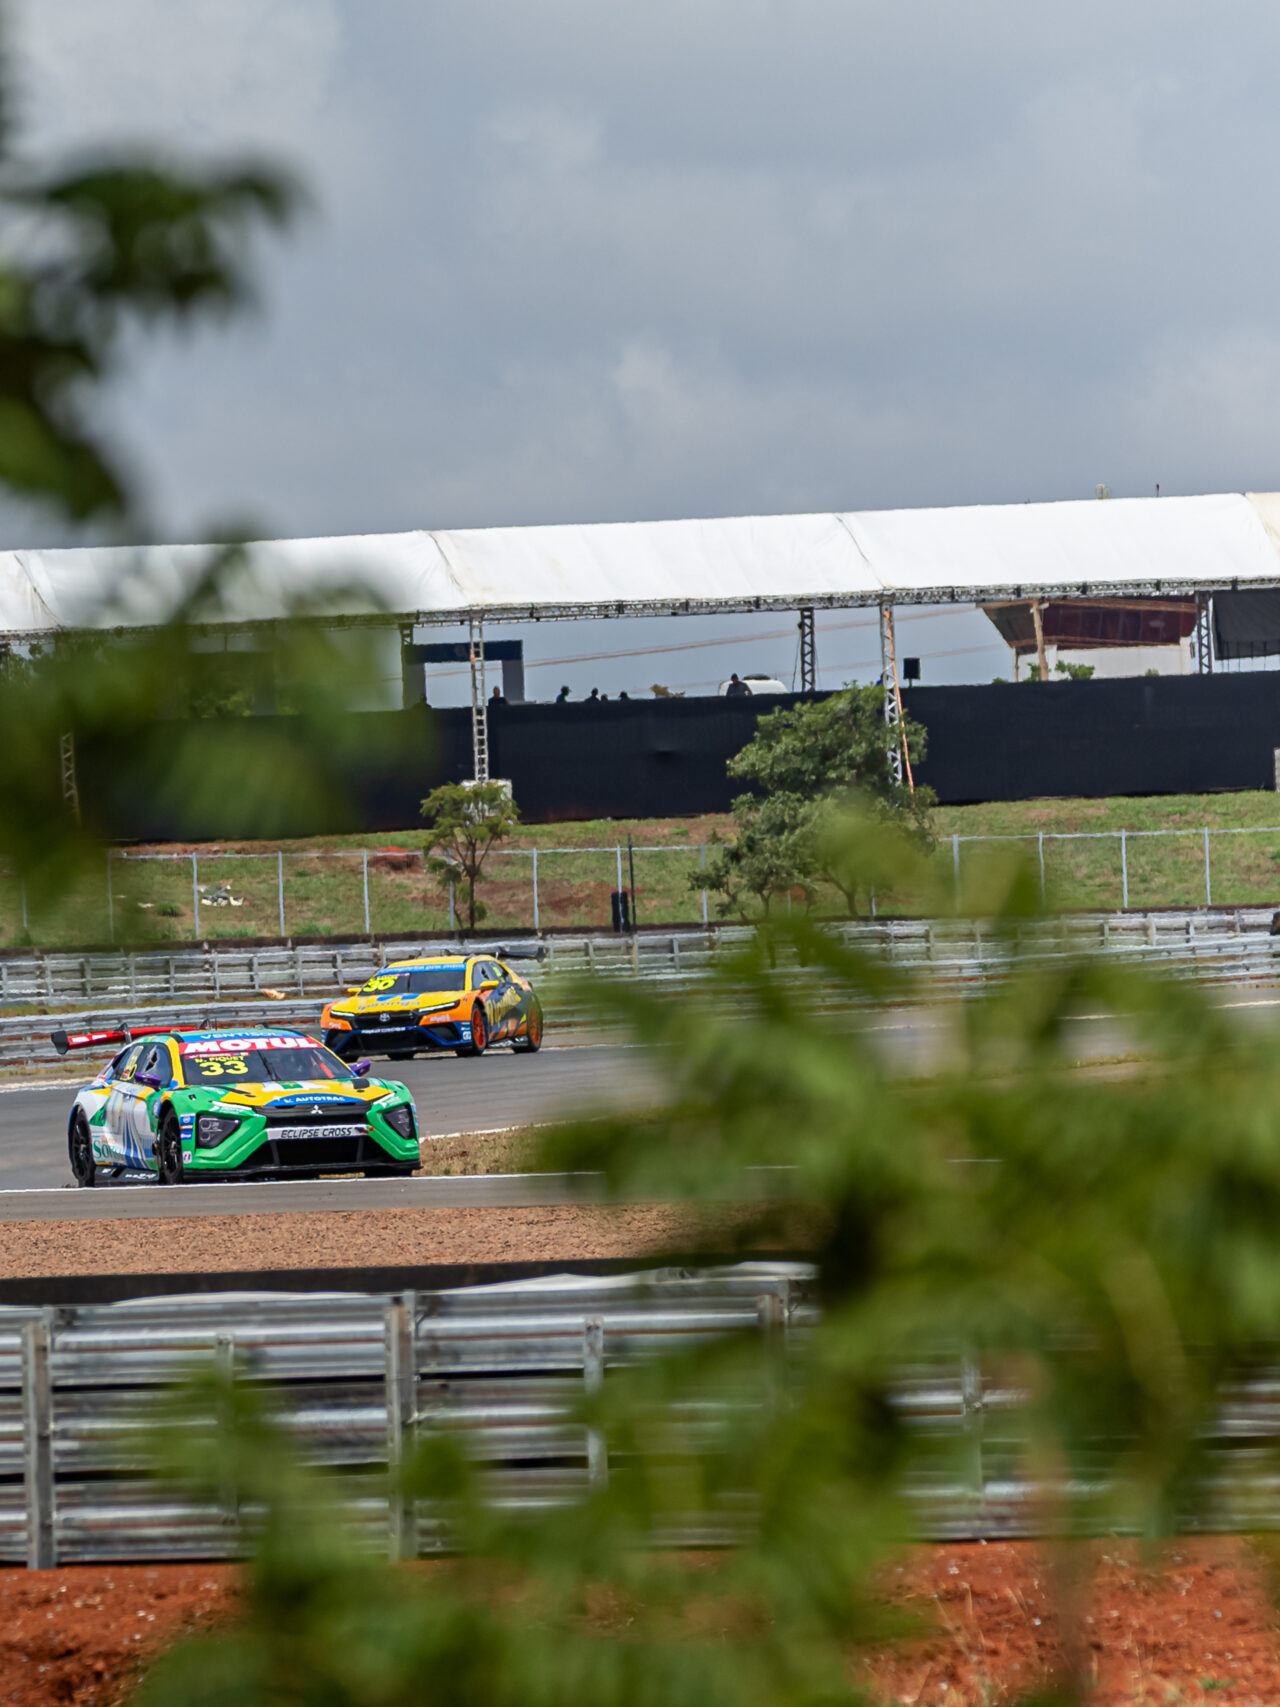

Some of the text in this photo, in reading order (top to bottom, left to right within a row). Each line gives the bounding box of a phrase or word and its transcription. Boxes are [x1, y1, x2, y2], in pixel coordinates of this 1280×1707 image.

[363, 979, 395, 992] 30
[184, 1038, 318, 1053] MOTUL
[200, 1060, 249, 1076] 33
[280, 1127, 352, 1139] ECLIPSE CROSS
